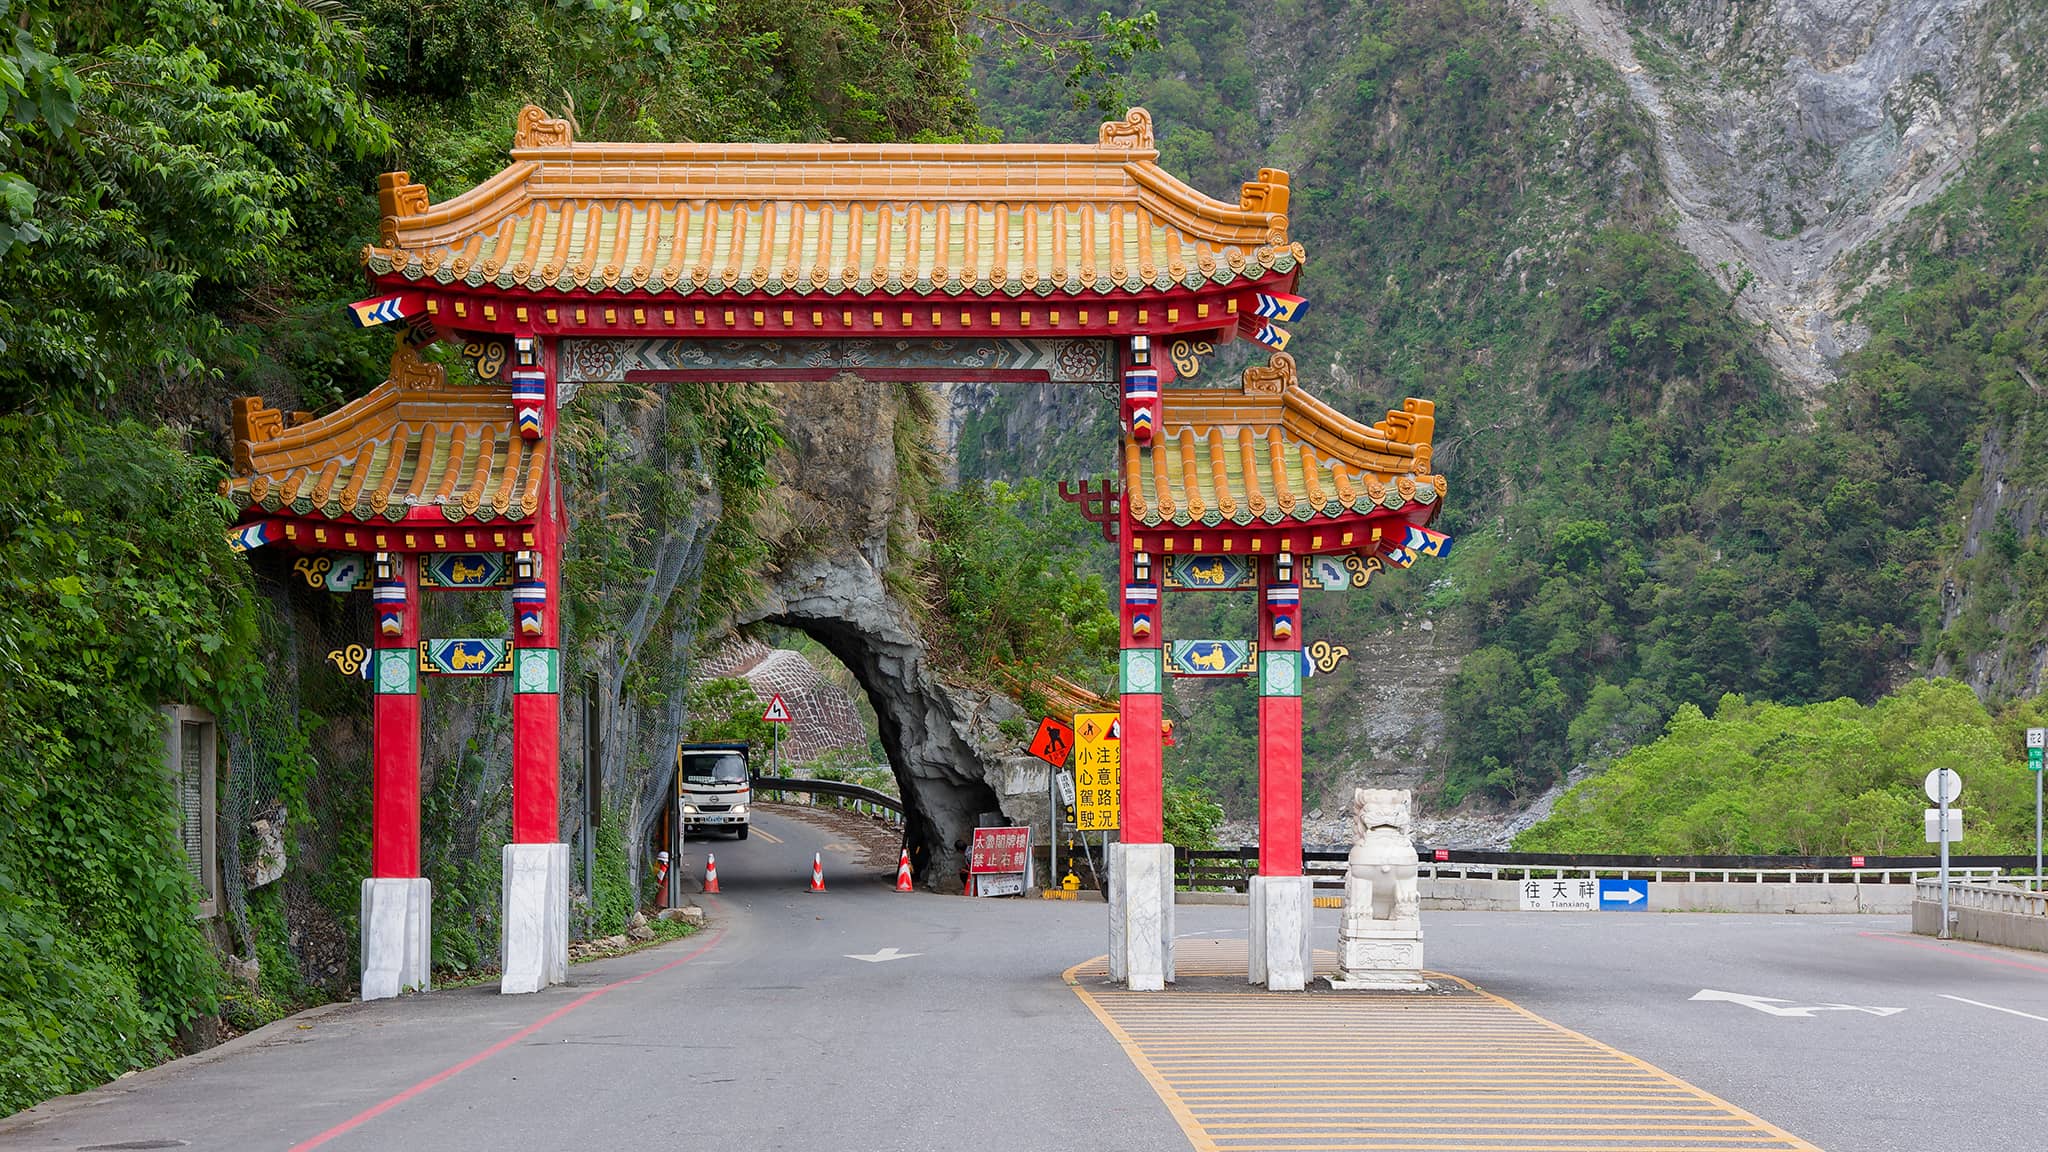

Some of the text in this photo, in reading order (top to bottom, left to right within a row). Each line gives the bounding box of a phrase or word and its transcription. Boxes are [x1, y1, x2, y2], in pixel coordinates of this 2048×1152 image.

[1079, 747, 1094, 828] 小心駕駛
[1097, 747, 1112, 828] 注意路況
[1525, 881, 1595, 898] 往天祥
[1551, 901, 1590, 909] Tianxiang
